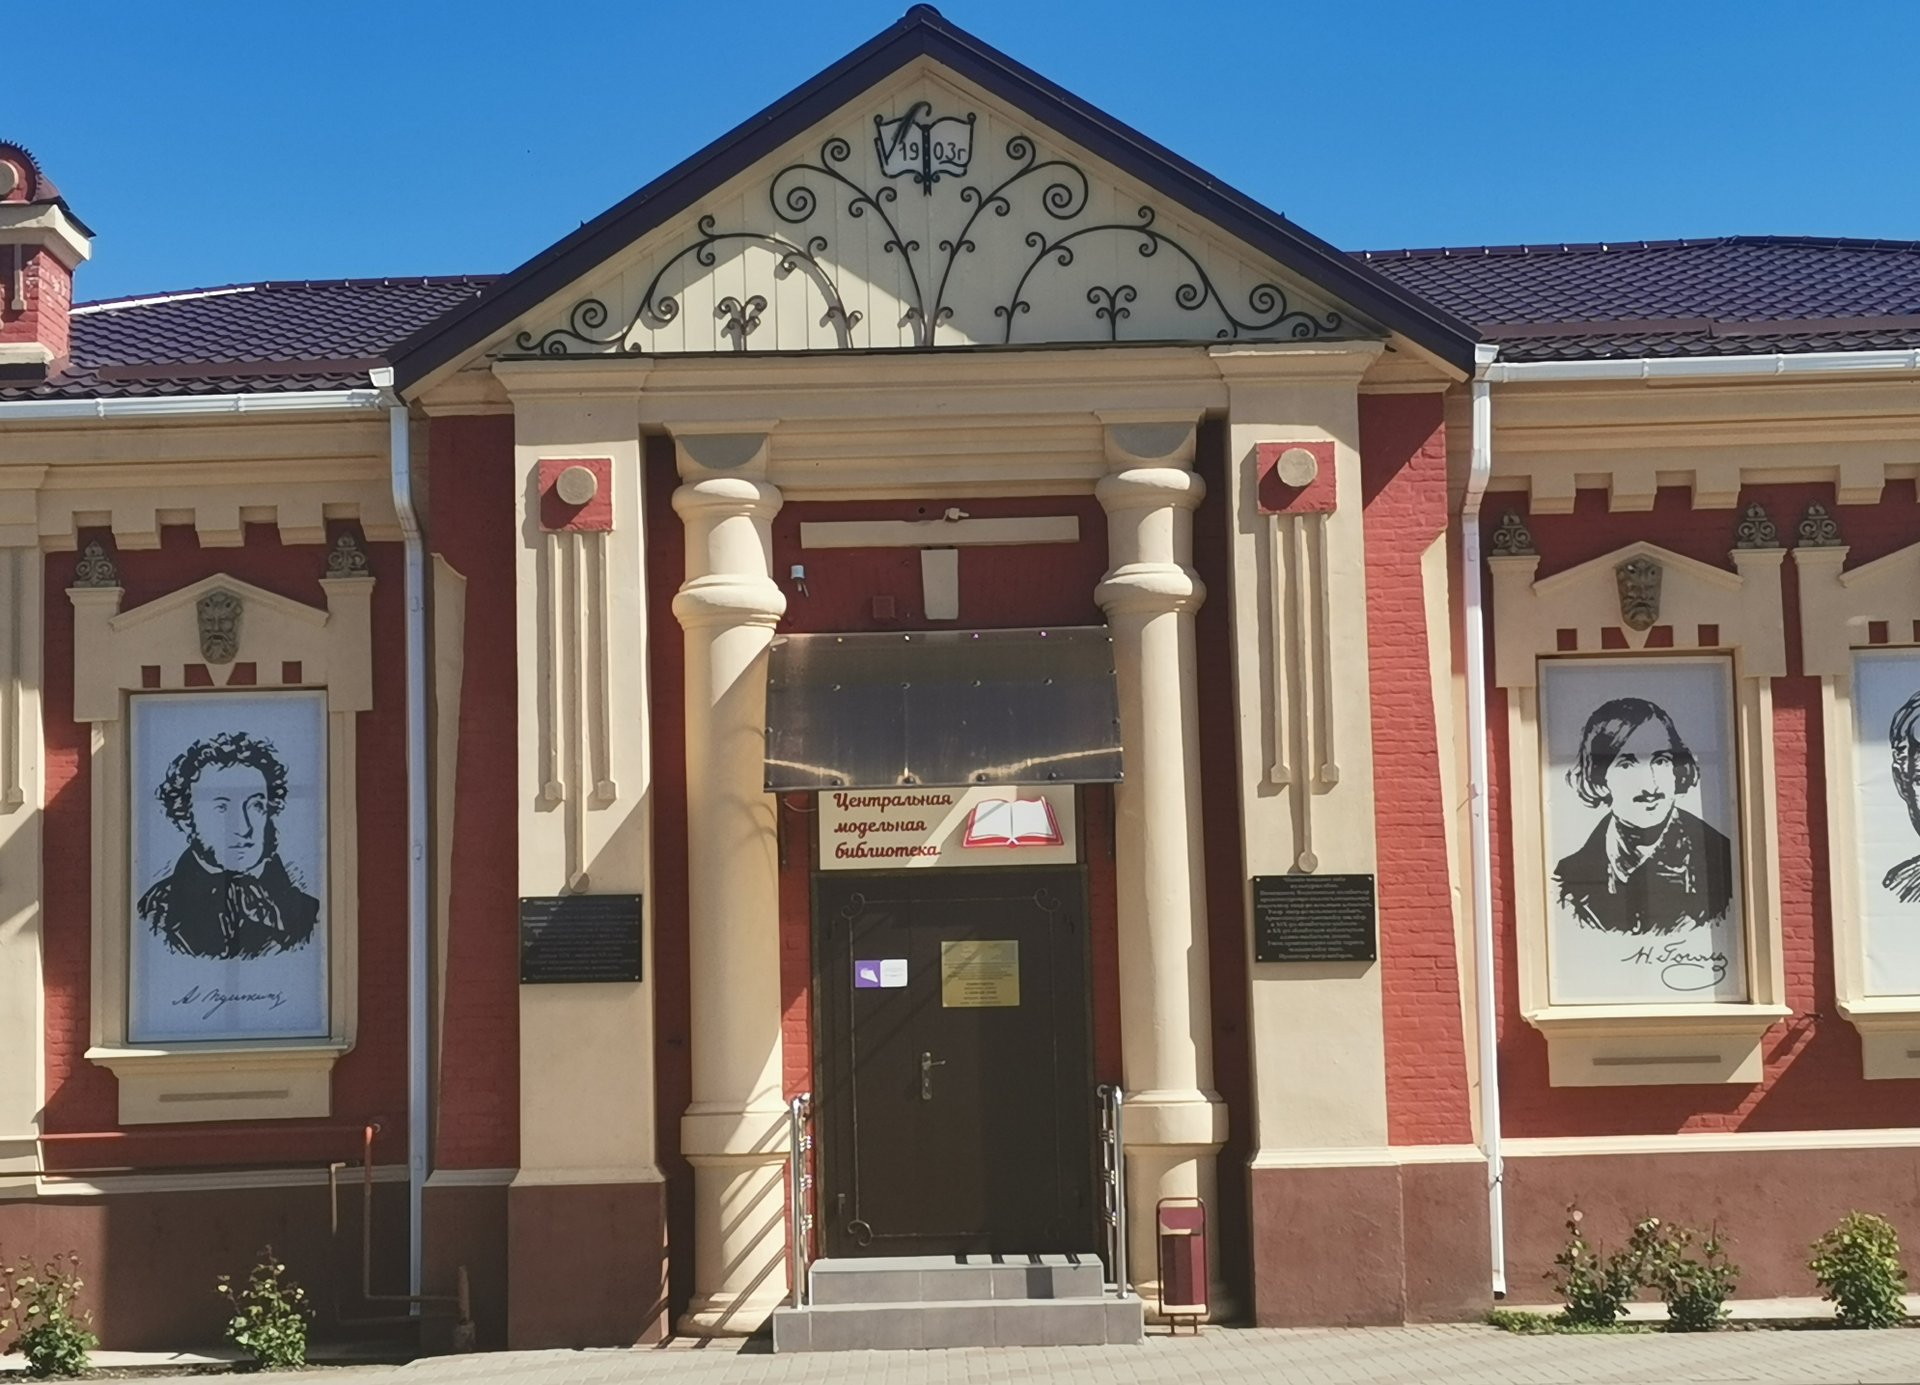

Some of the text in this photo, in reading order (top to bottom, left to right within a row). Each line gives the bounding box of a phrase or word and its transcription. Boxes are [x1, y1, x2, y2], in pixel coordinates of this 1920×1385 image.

[833, 793, 953, 813] Центральная
[833, 819, 927, 838] модельная
[835, 841, 942, 859] библиотека
